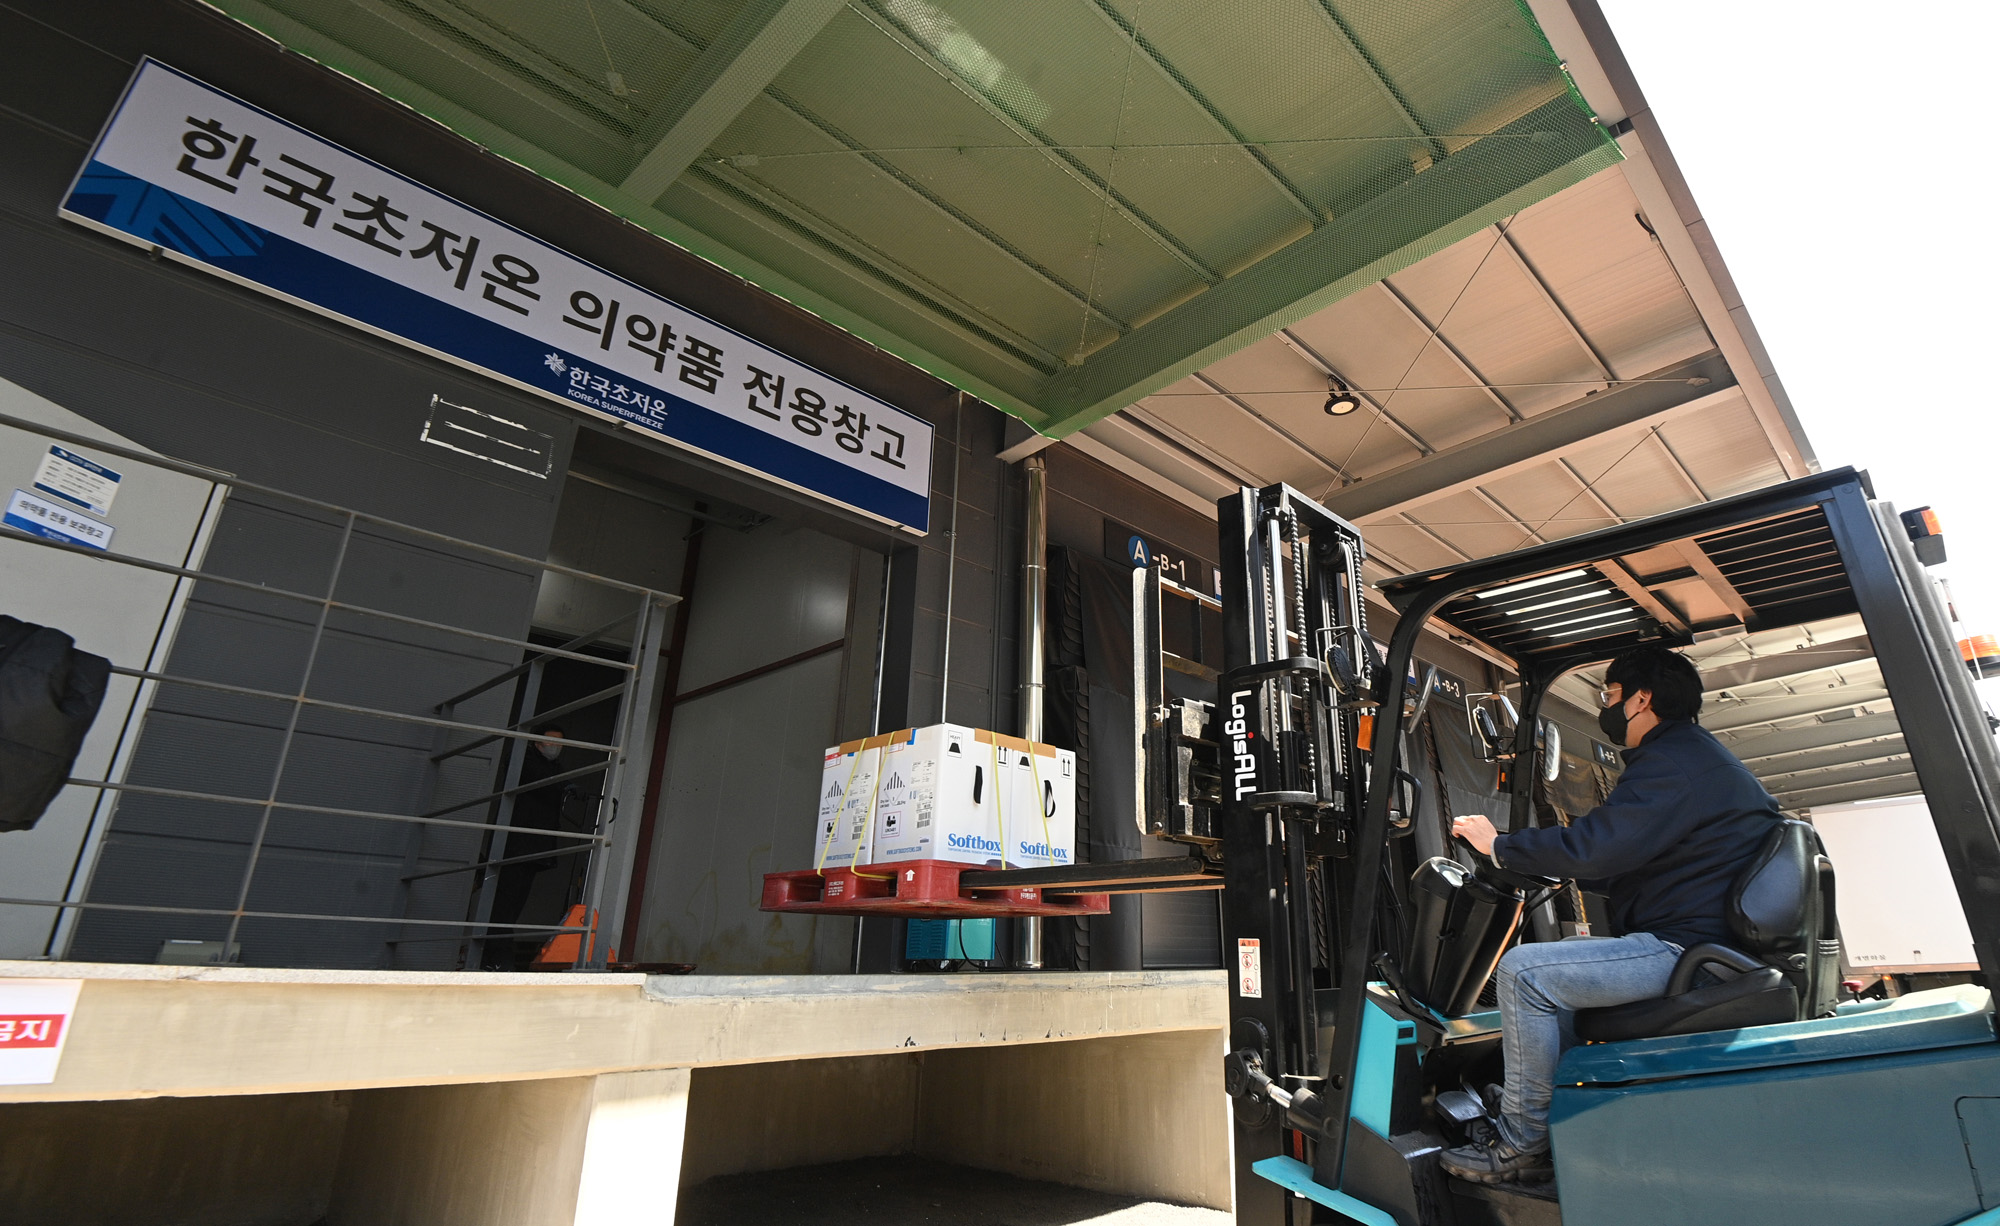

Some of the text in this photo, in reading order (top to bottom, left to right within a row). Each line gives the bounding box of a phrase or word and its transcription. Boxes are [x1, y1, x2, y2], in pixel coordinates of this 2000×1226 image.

[176, 116, 906, 470] 한국초저온 의약품 전용창고
[567, 388, 664, 430] KOREA SUPERFREEZE
[569, 366, 668, 421] 한국초저온
[1224, 690, 1257, 801] LogisALL
[948, 833, 1001, 852] Softbox
[1020, 841, 1068, 859] Softbox
